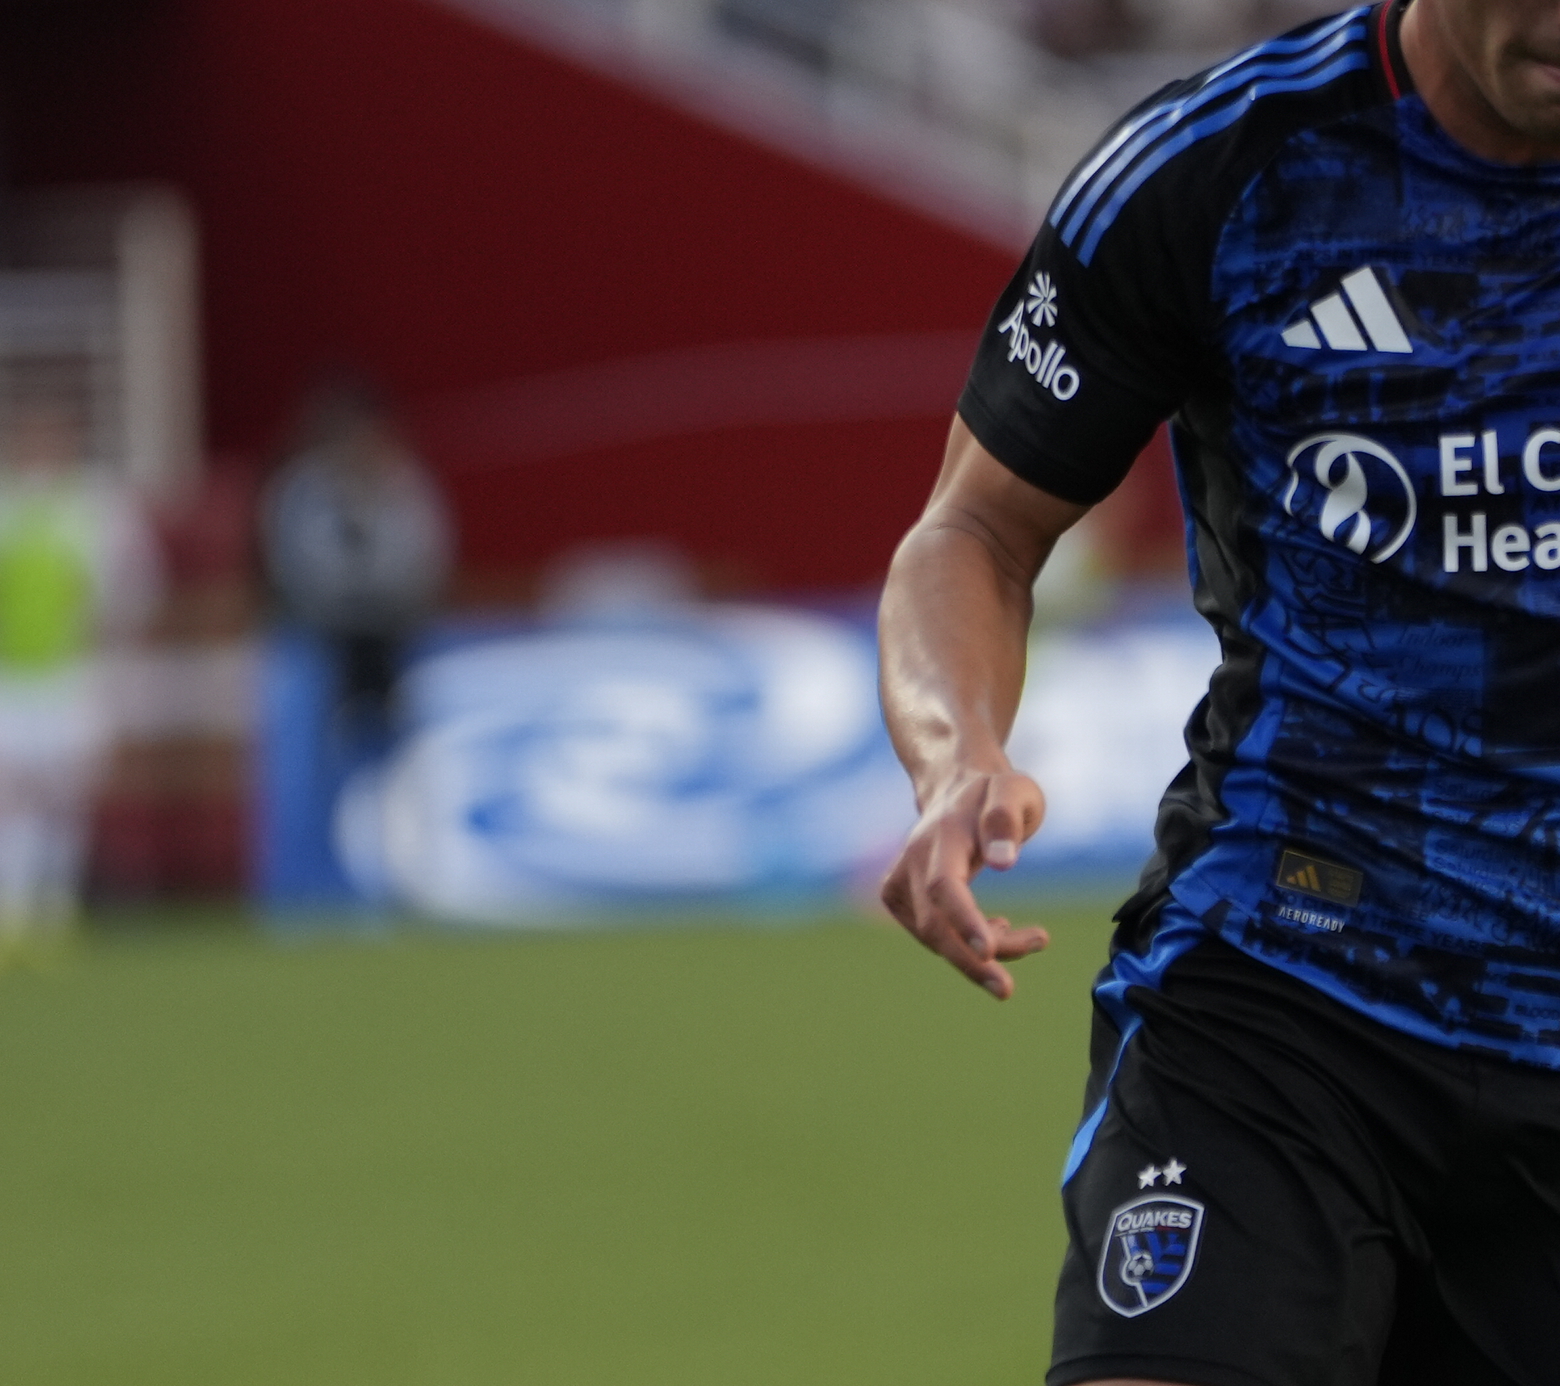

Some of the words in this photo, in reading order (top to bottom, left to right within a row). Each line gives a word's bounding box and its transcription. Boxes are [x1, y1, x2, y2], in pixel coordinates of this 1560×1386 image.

[998, 299, 1080, 401] Apollo
[1440, 429, 1505, 496] El
[1279, 906, 1346, 932] AEROREADY
[1117, 1212, 1193, 1232] QUAKES
